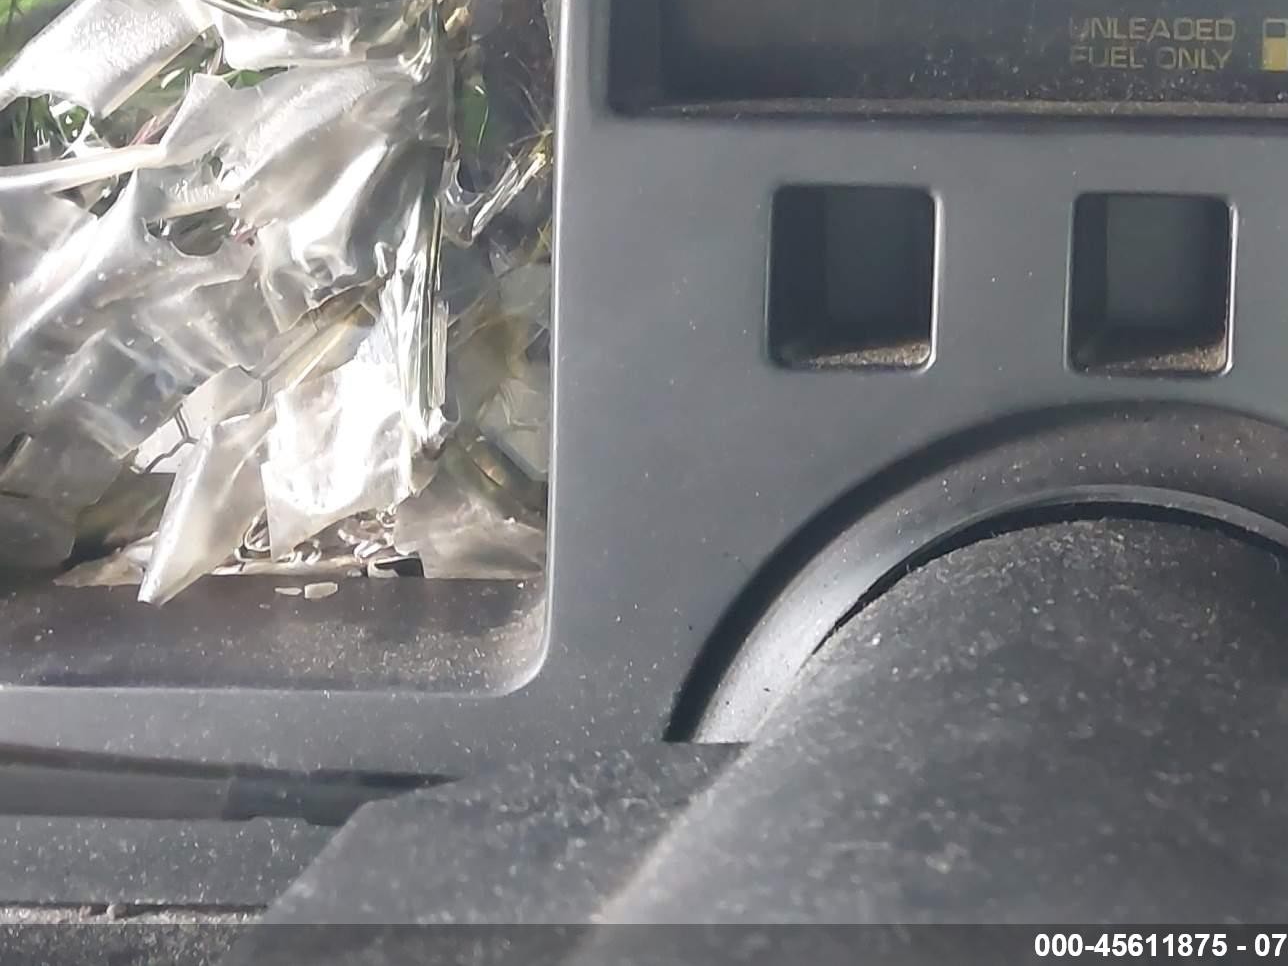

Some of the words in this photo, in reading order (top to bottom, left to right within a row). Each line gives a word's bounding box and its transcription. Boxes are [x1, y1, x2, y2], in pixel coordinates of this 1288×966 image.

[1070, 16, 1236, 42] UNLEADED
[1070, 46, 1145, 70] FUEL
[1156, 47, 1233, 71] ONLY
